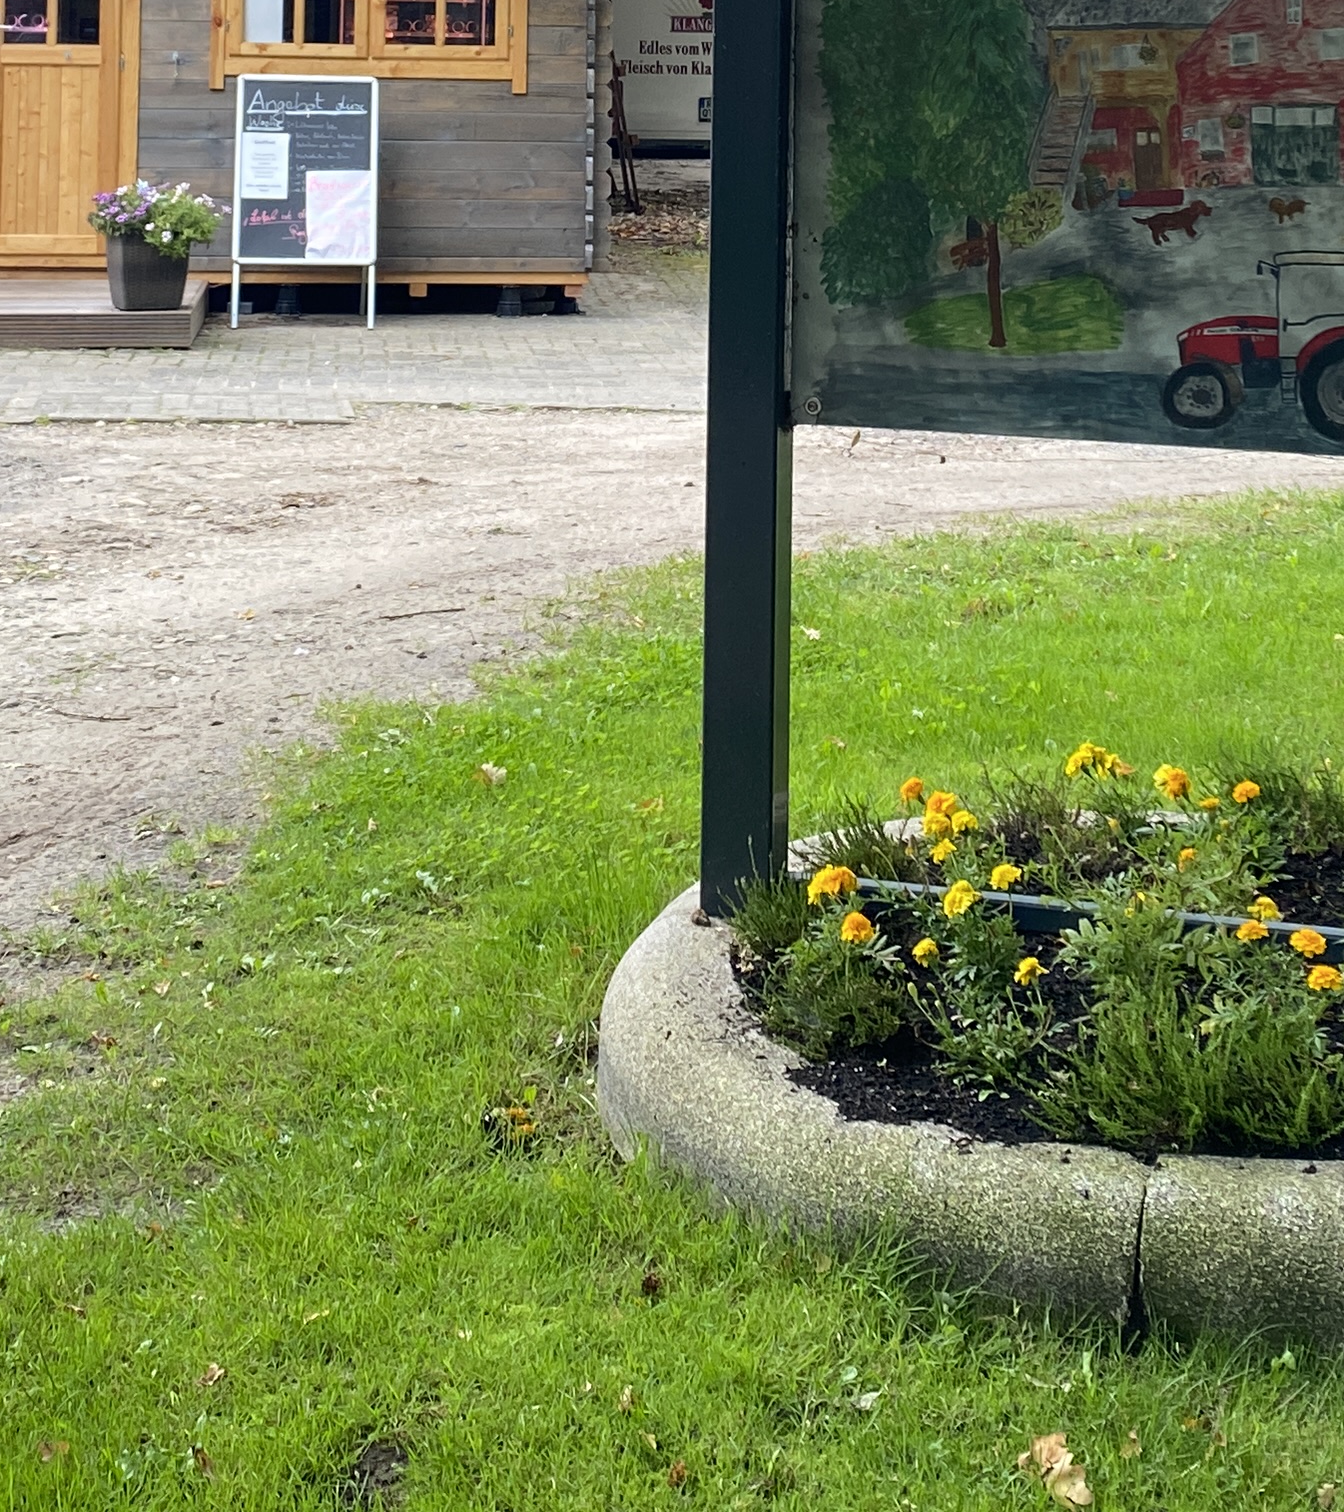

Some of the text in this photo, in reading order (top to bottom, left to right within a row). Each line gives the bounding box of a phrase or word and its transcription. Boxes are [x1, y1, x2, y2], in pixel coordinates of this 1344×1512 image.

[639, 40, 672, 55] Edles
[675, 45, 699, 55] vom
[666, 64, 688, 75] von
[247, 89, 325, 121] Angebot
